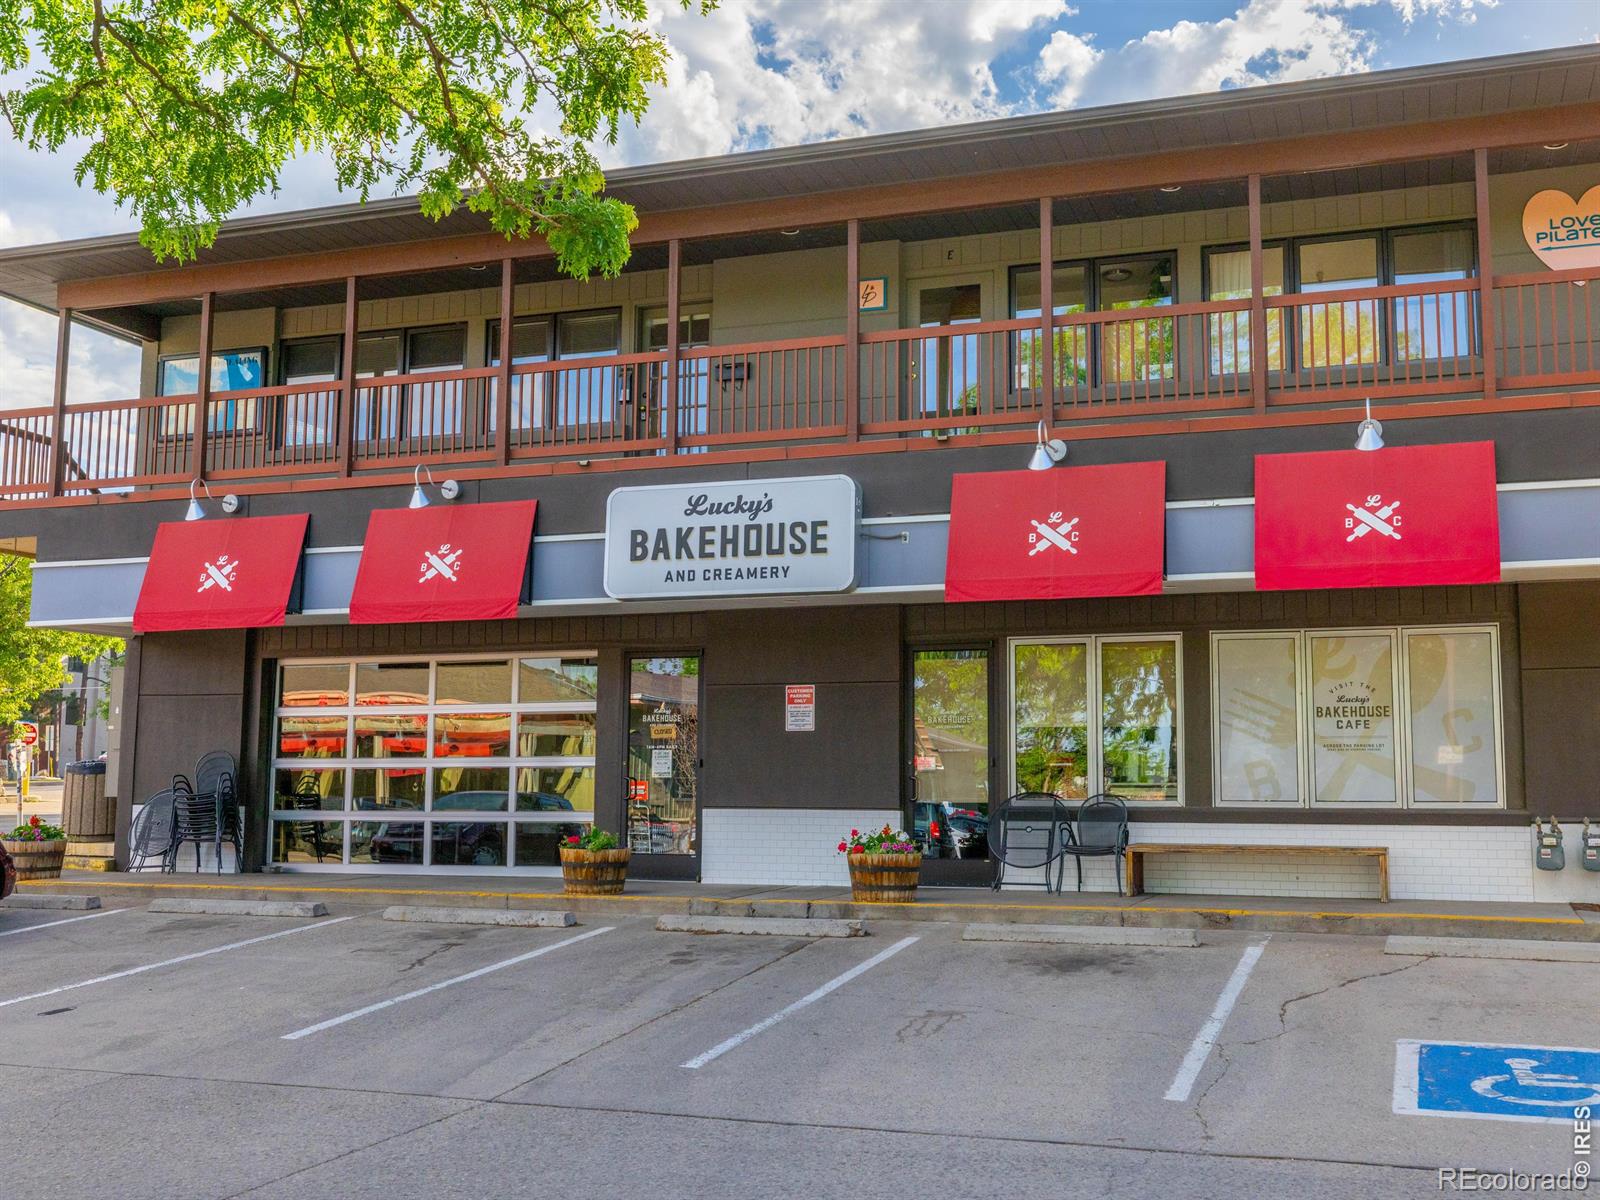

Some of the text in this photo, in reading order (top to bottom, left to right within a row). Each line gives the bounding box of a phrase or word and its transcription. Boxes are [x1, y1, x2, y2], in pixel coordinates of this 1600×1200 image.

[947, 249, 954, 260] E
[684, 493, 773, 520] Lucky's
[630, 520, 828, 562] BAKEHOUSE
[665, 566, 790, 583] AND CREAMERY
[1328, 681, 1376, 694] VISIT THE
[1336, 695, 1370, 705] Lucky's
[1316, 705, 1391, 718] BAKEHOUSE
[642, 714, 681, 722] BAKEHOUSE
[927, 715, 972, 724] BAKEHOUSE
[1336, 720, 1370, 729] CAFE
